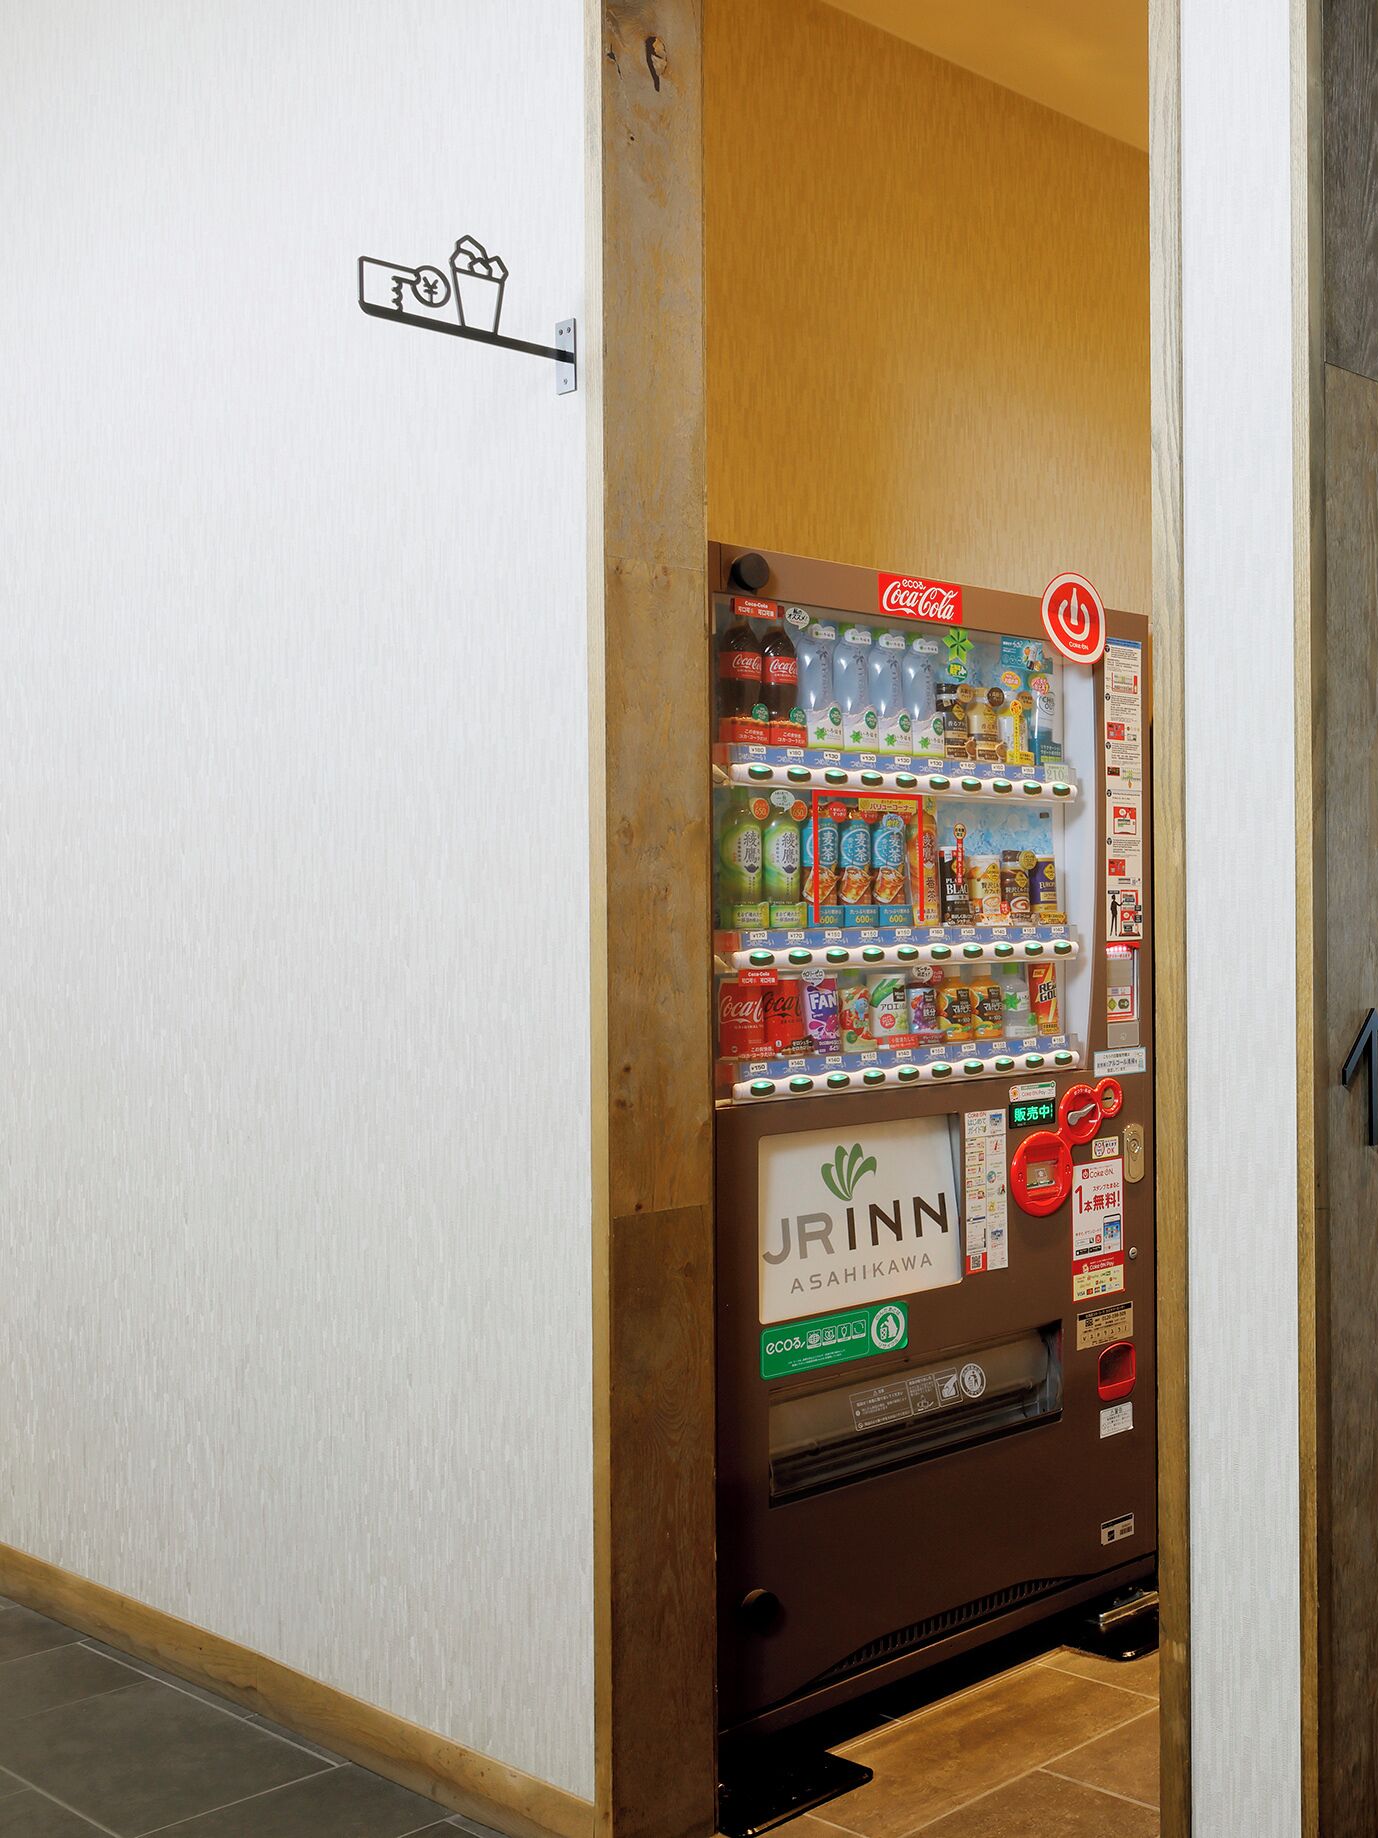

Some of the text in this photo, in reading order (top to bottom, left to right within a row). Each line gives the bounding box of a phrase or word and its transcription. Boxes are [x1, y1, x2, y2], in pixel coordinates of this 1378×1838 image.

[744, 600, 768, 609] Coca-Cola
[882, 581, 959, 620] Coca-Cola
[822, 832, 834, 861] 麦茶
[854, 832, 867, 862] 麦茶
[1014, 1104, 1050, 1123] 販売中
[762, 1212, 835, 1265] JR
[846, 1192, 949, 1251] INN
[790, 1252, 933, 1295] ASAHIKAWA
